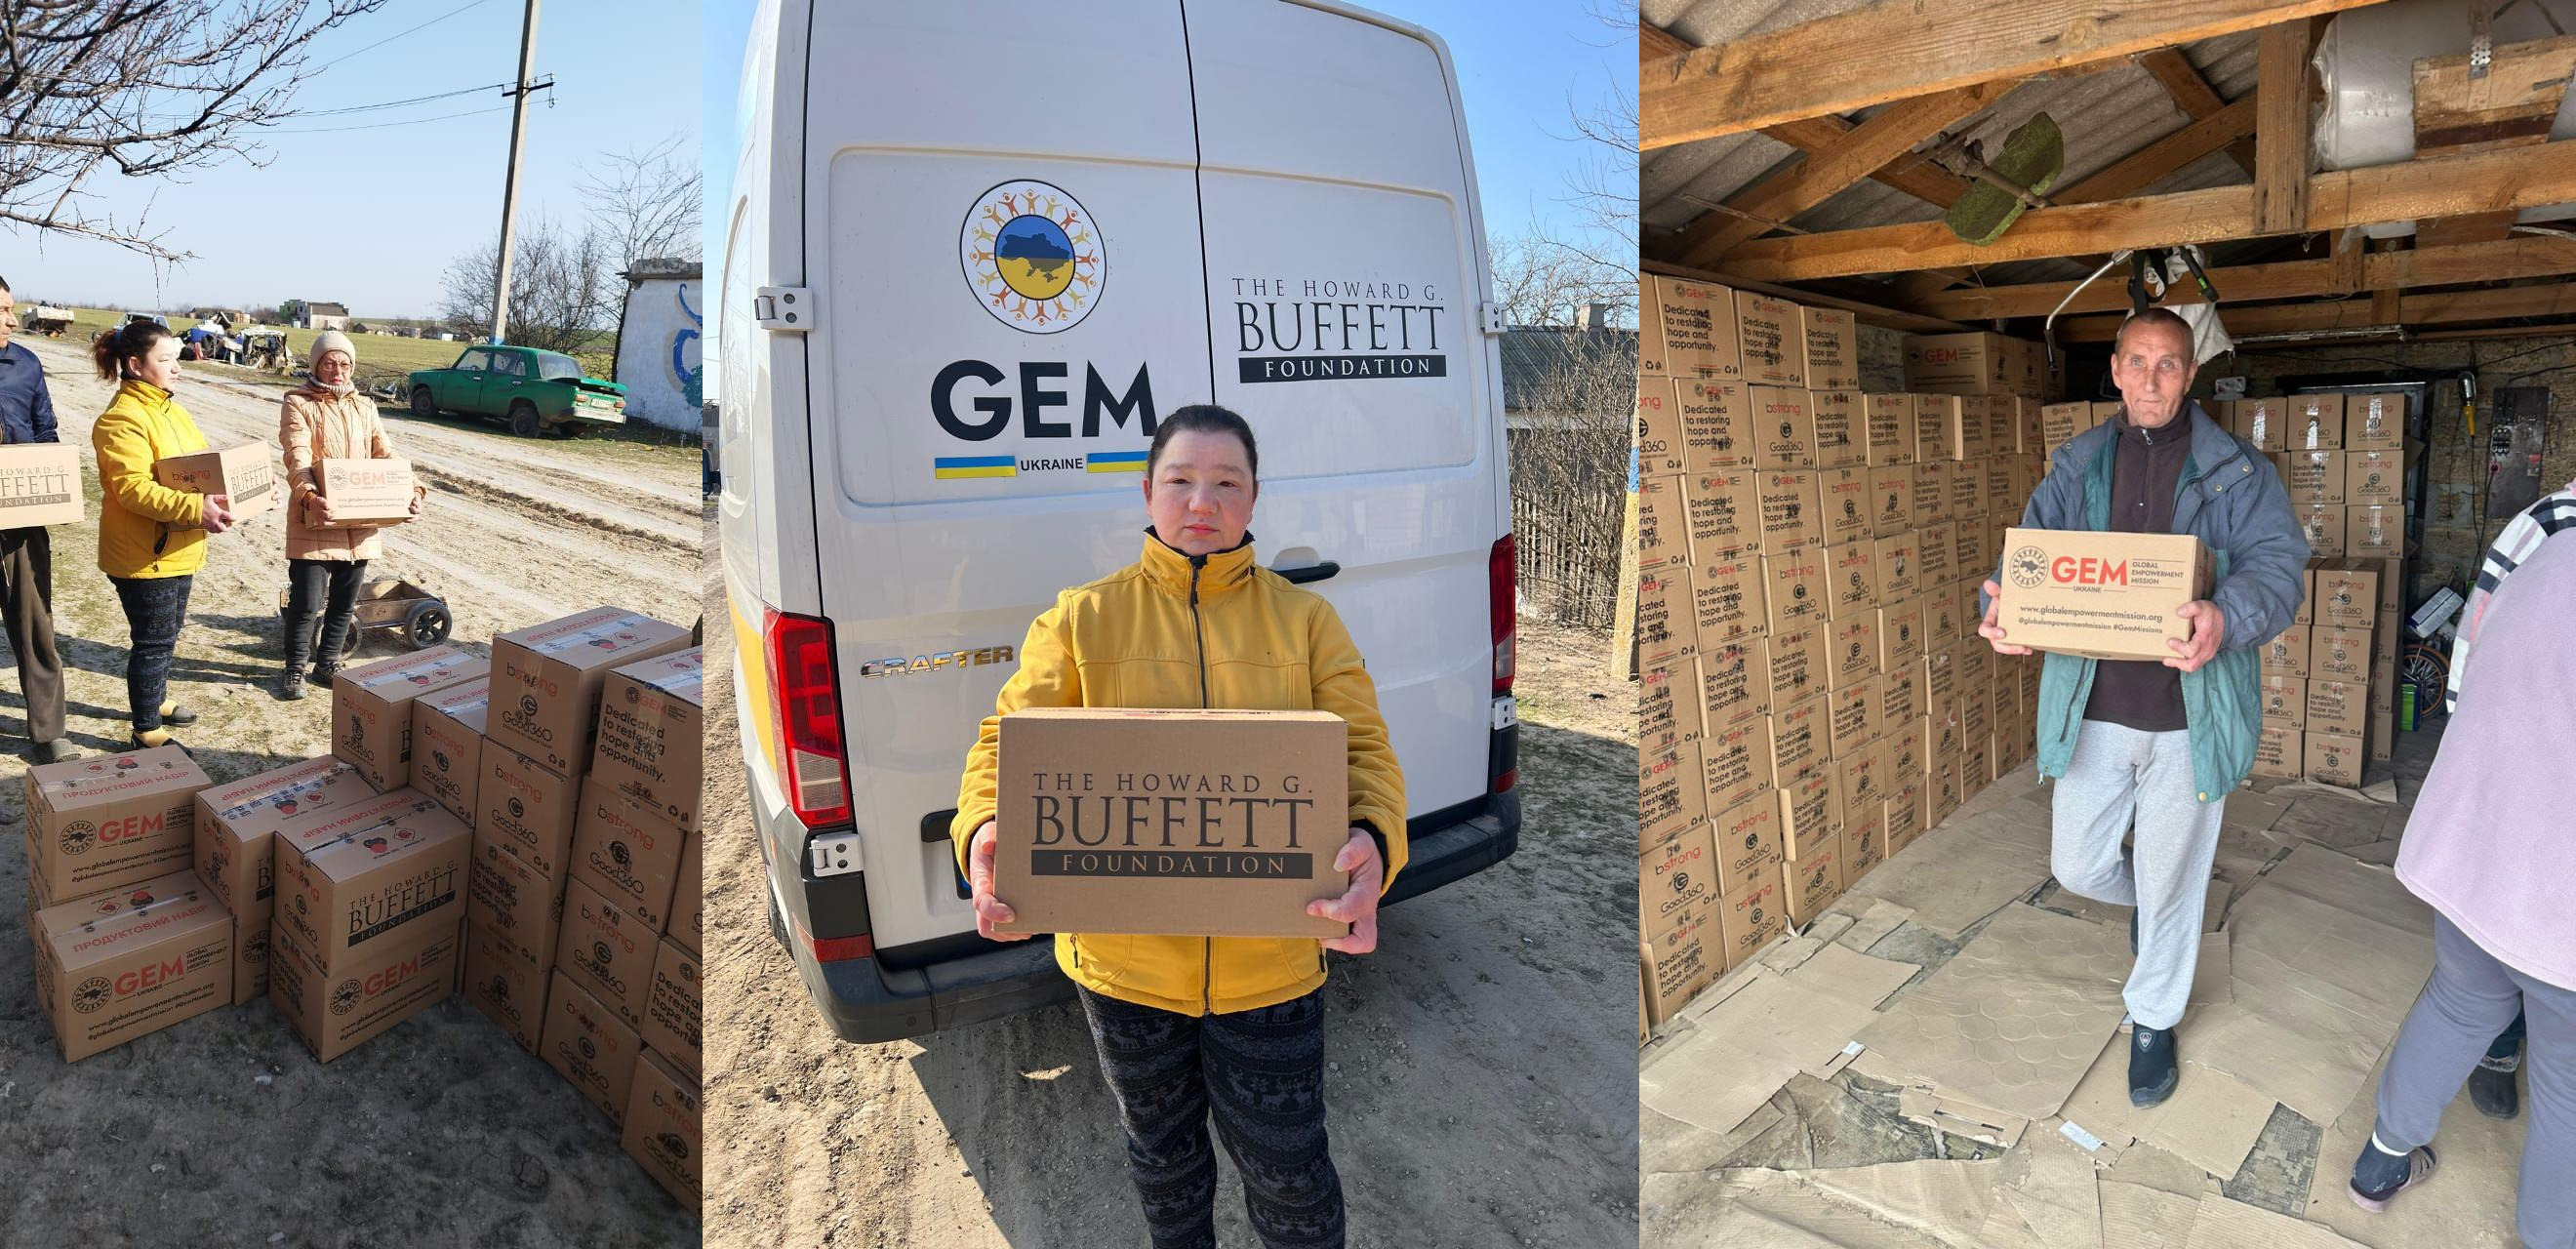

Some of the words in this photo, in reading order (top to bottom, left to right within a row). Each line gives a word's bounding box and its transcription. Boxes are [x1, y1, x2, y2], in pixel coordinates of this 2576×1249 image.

[1233, 278, 1284, 296] THE
[1304, 280, 1411, 301] HOWARD
[1426, 284, 1444, 301] G.
[1236, 302, 1445, 352] BUFFETT
[1666, 316, 1674, 326] to
[1744, 316, 1780, 330] Dedicated
[1668, 328, 1689, 340] hope
[1693, 330, 1709, 341] and
[1669, 341, 1718, 353] opportunity.
[1745, 338, 1763, 349] hope
[1809, 349, 1826, 358] hope
[1924, 347, 1958, 363] GEM
[1266, 358, 1430, 378] FOUNDATION
[1810, 357, 1843, 367] opportunity.
[931, 360, 1158, 442] GEM
[1685, 405, 1727, 414] Dedicated
[1766, 403, 1801, 416] bstrong
[1816, 413, 1847, 422] Dedicated
[1696, 417, 1730, 426] restoring
[1687, 427, 1709, 436] hope
[1770, 441, 1803, 452] Good360
[1021, 458, 1084, 472] UKRAINE
[2358, 461, 2393, 469] bstrong
[349, 472, 385, 485] GEM
[1711, 478, 1730, 487] GEM
[1878, 480, 1905, 490] bstrong
[1832, 481, 1861, 494] bstrong
[1763, 493, 1798, 503] Dedicated
[1692, 509, 1701, 518] to
[1764, 512, 1784, 522] hope
[1880, 510, 1906, 522] Good360
[1694, 518, 1715, 529] hope
[1717, 516, 1732, 525] and
[1766, 521, 1805, 532] opportunity.
[1695, 526, 1741, 540] opportunity.
[1717, 566, 1736, 575] GEM
[1780, 564, 1814, 580] bstrong
[2051, 556, 2127, 585] GEM
[2131, 570, 2184, 579] EMPOWERMENT
[1697, 583, 1740, 597] Dedicated
[1699, 598, 1707, 607] to
[1700, 606, 1721, 618] hope
[1723, 602, 1739, 612] and
[1701, 611, 1747, 627] opportunity.
[1891, 611, 1916, 626] bstrong
[2020, 604, 2162, 624] www.globalempowermentmission.org
[2019, 617, 2112, 630] @globalempowermentmission
[2113, 624, 2162, 634] #GemMissions
[2324, 636, 2359, 648] bstrong
[860, 645, 1014, 678] CRAFTER
[1772, 649, 1805, 665] Dedicated
[1782, 658, 1808, 670] restoring
[1716, 674, 1747, 689] restoring
[1774, 672, 1791, 683] hope
[1709, 691, 1727, 703] hope
[2310, 706, 2326, 715] hope
[603, 717, 614, 729] to
[606, 705, 665, 739] Dedicated
[601, 730, 629, 749] hope
[1727, 731, 1744, 744] GEM
[1776, 724, 1809, 743] Dedicated
[1778, 747, 1795, 759] hope
[1797, 741, 1809, 751] and
[1778, 747, 1815, 768] opportunity.
[600, 743, 665, 783] opportunity.
[1708, 765, 1716, 777] to
[1717, 753, 1750, 773] restoring
[423, 764, 461, 795] Good360
[1710, 770, 1729, 785] hope
[1732, 765, 1747, 779] and
[2315, 767, 2350, 777] Good360
[496, 765, 542, 803] bstrong
[1033, 773, 1094, 791] THE
[1117, 774, 1261, 792] HOWARD
[1282, 776, 1313, 794] G.
[1711, 771, 1754, 794] opportunity.
[99, 813, 164, 843] GEM
[492, 809, 538, 844] Good360
[597, 803, 655, 851] bstrong
[1031, 795, 1313, 849] BUFFETT
[1731, 810, 1768, 835] bstrong
[303, 823, 336, 838] НАБІР
[1062, 854, 1285, 874] FOUNDATION
[1655, 845, 1702, 875] bstrong
[1735, 843, 1771, 869] Good360
[1802, 850, 1832, 876] bstrong
[589, 852, 644, 894] Good360
[349, 893, 376, 909] THE
[384, 867, 440, 895] HOWARD
[348, 867, 458, 934] BUFFETT
[1661, 882, 1705, 914] Good360
[361, 896, 447, 941] FOUNDATION
[73, 916, 170, 952] ПРОДУКТОВИЙ
[172, 905, 208, 922] НАБІР
[582, 905, 634, 953] bstrong
[1676, 923, 1696, 940] GEM
[1740, 915, 1776, 945] Good360
[1658, 938, 1700, 970] Dedicated
[114, 954, 183, 995] GEM
[364, 955, 419, 996] GEM
[1659, 968, 1669, 980] to
[1661, 973, 1681, 988] hope
[1662, 962, 1708, 998] opportunity.
[656, 983, 665, 998] to
[653, 993, 682, 1023] hope
